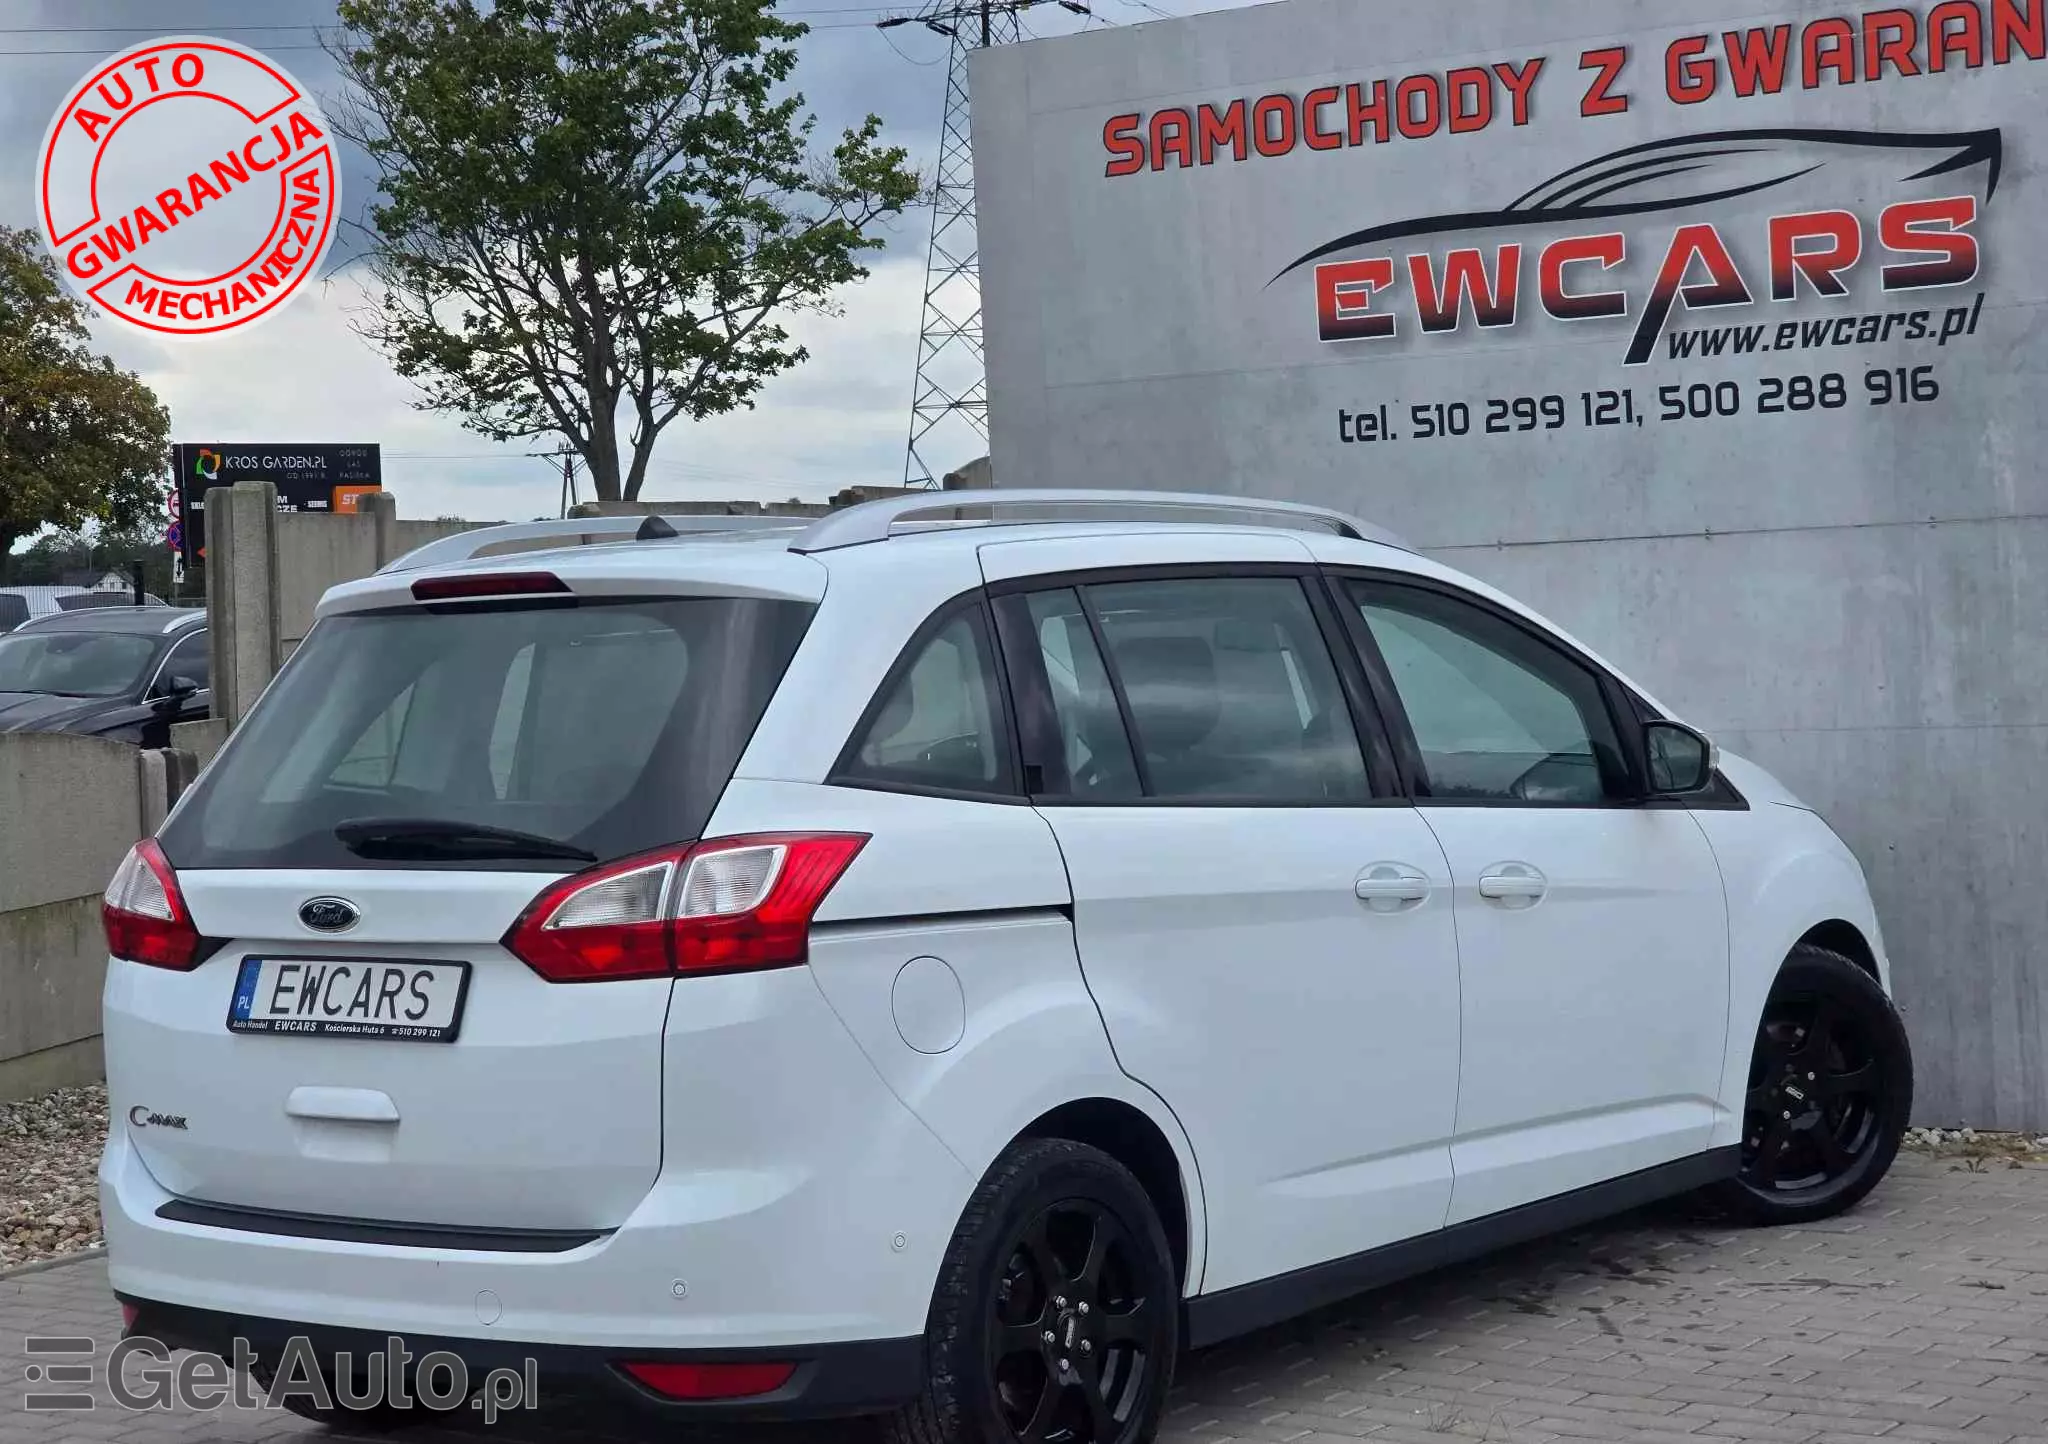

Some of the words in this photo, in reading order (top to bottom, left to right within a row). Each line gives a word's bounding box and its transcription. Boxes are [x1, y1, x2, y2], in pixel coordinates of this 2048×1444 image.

[1102, 57, 1546, 177] SAMOCHODY
[1578, 46, 1628, 118] Z
[1314, 195, 1979, 366] EWCARS
[1668, 293, 1986, 360] www.ewcars.pl
[1338, 406, 1397, 443] tel.
[1412, 401, 1469, 440] 510
[1485, 395, 1564, 434] 299
[1583, 389, 1643, 429] 121,
[1660, 379, 1740, 422] 500
[1757, 372, 1847, 414] 288
[1864, 365, 1940, 405] 916
[225, 456, 258, 469] KROS
[262, 455, 328, 469] GARDEN.PL
[310, 903, 345, 923] Ford
[237, 996, 251, 1009] PL
[269, 964, 434, 1021] EWCARS
[274, 1020, 317, 1032] EWCARS
[398, 1028, 411, 1036] 510
[412, 1028, 427, 1037] 299
